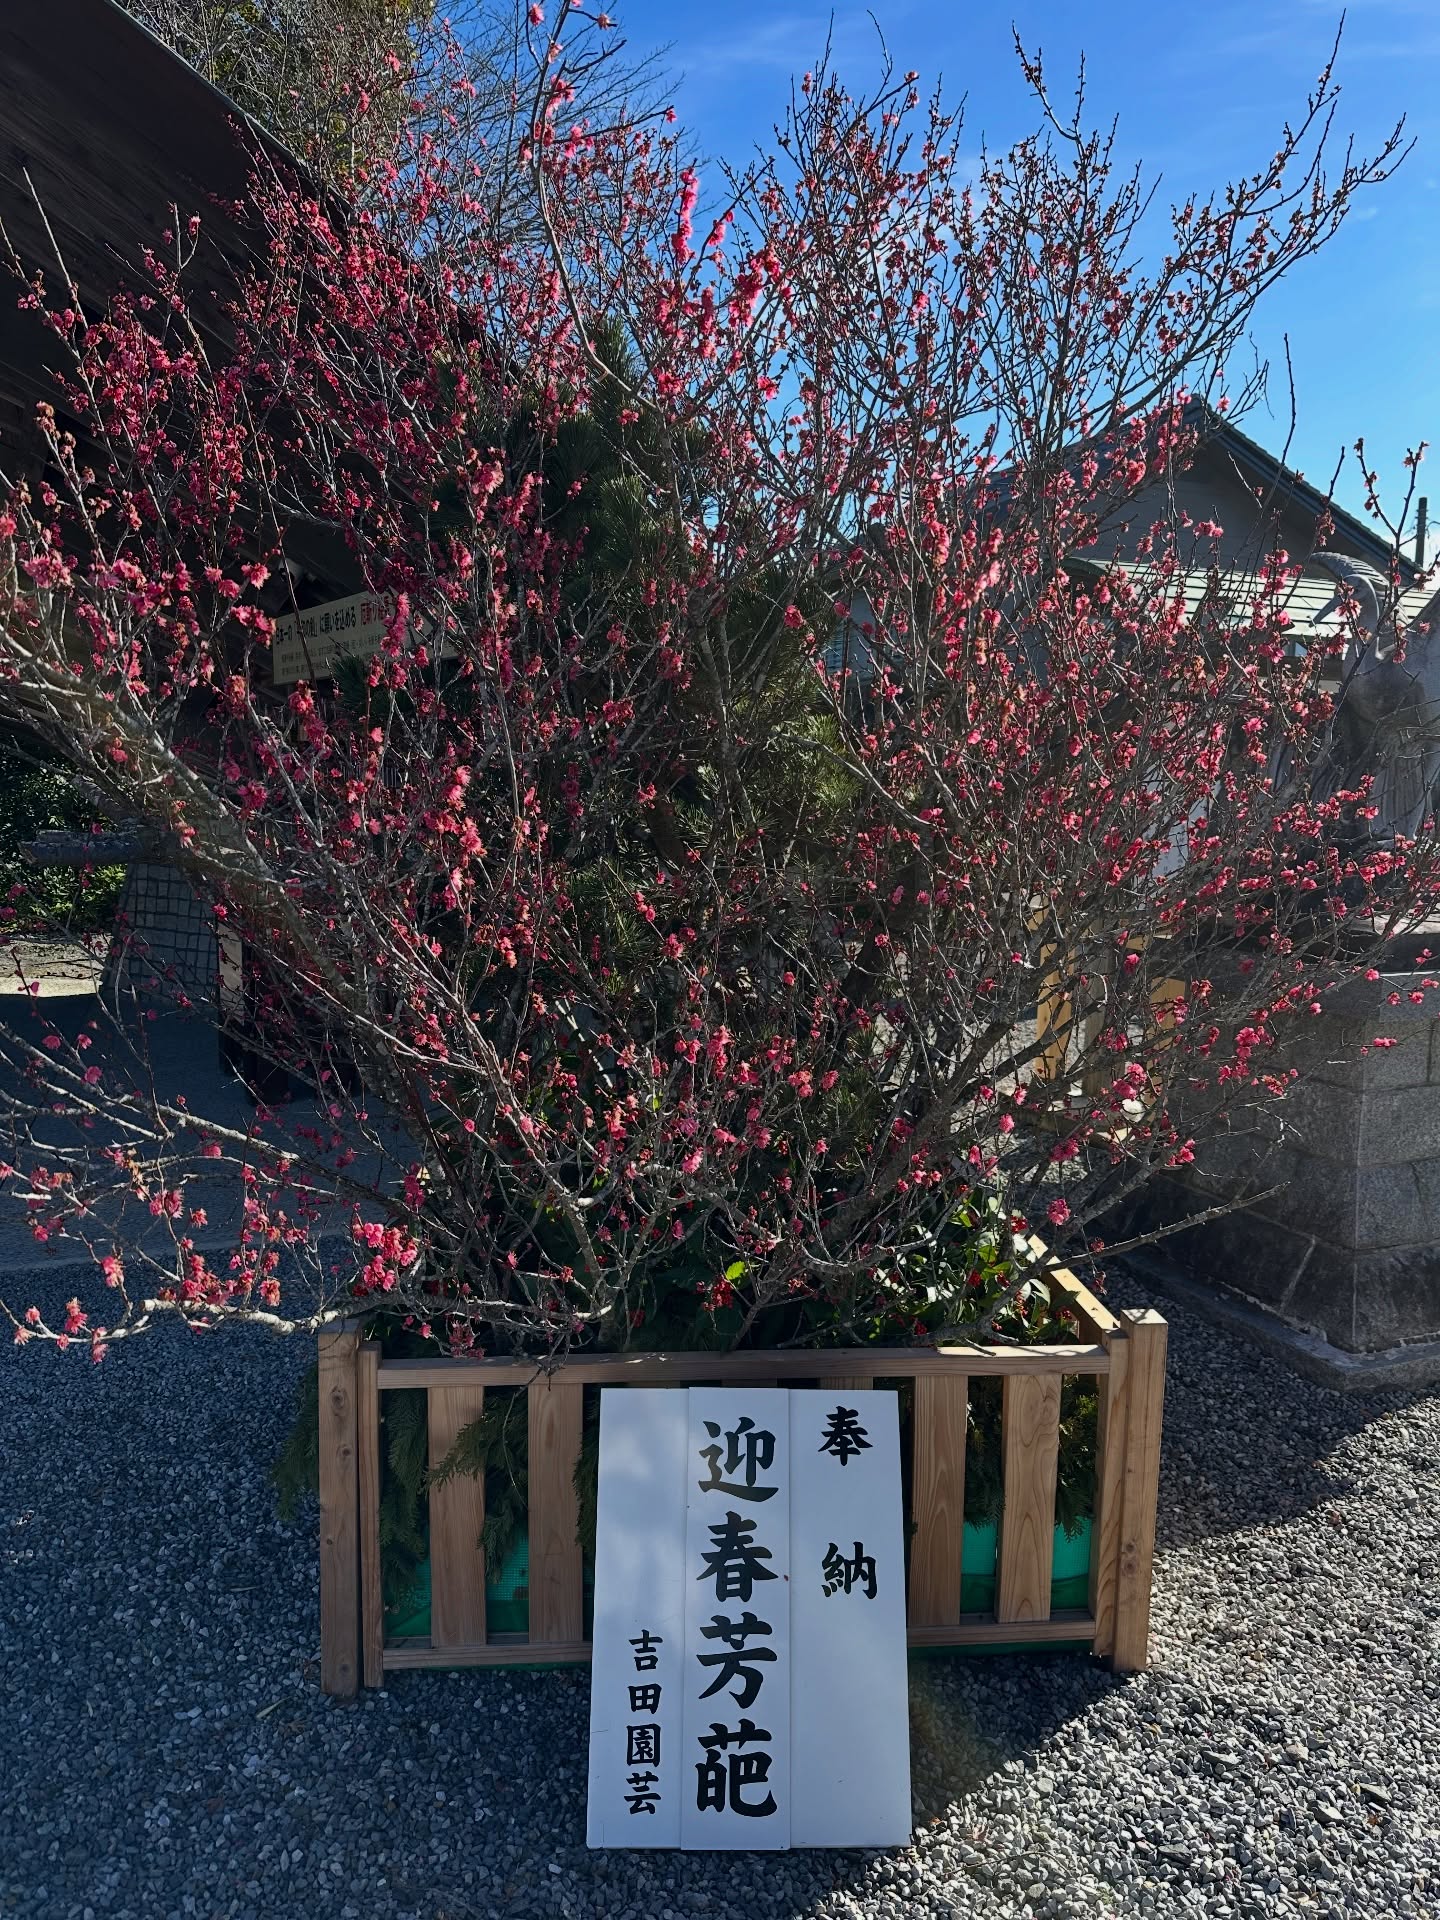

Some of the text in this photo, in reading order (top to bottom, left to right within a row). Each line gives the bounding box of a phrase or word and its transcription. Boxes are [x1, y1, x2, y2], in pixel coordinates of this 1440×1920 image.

[818, 1405, 878, 1600] 奉納
[695, 1416, 780, 1818] 迎春芳葩
[624, 1629, 664, 1815] 吉田園芸
